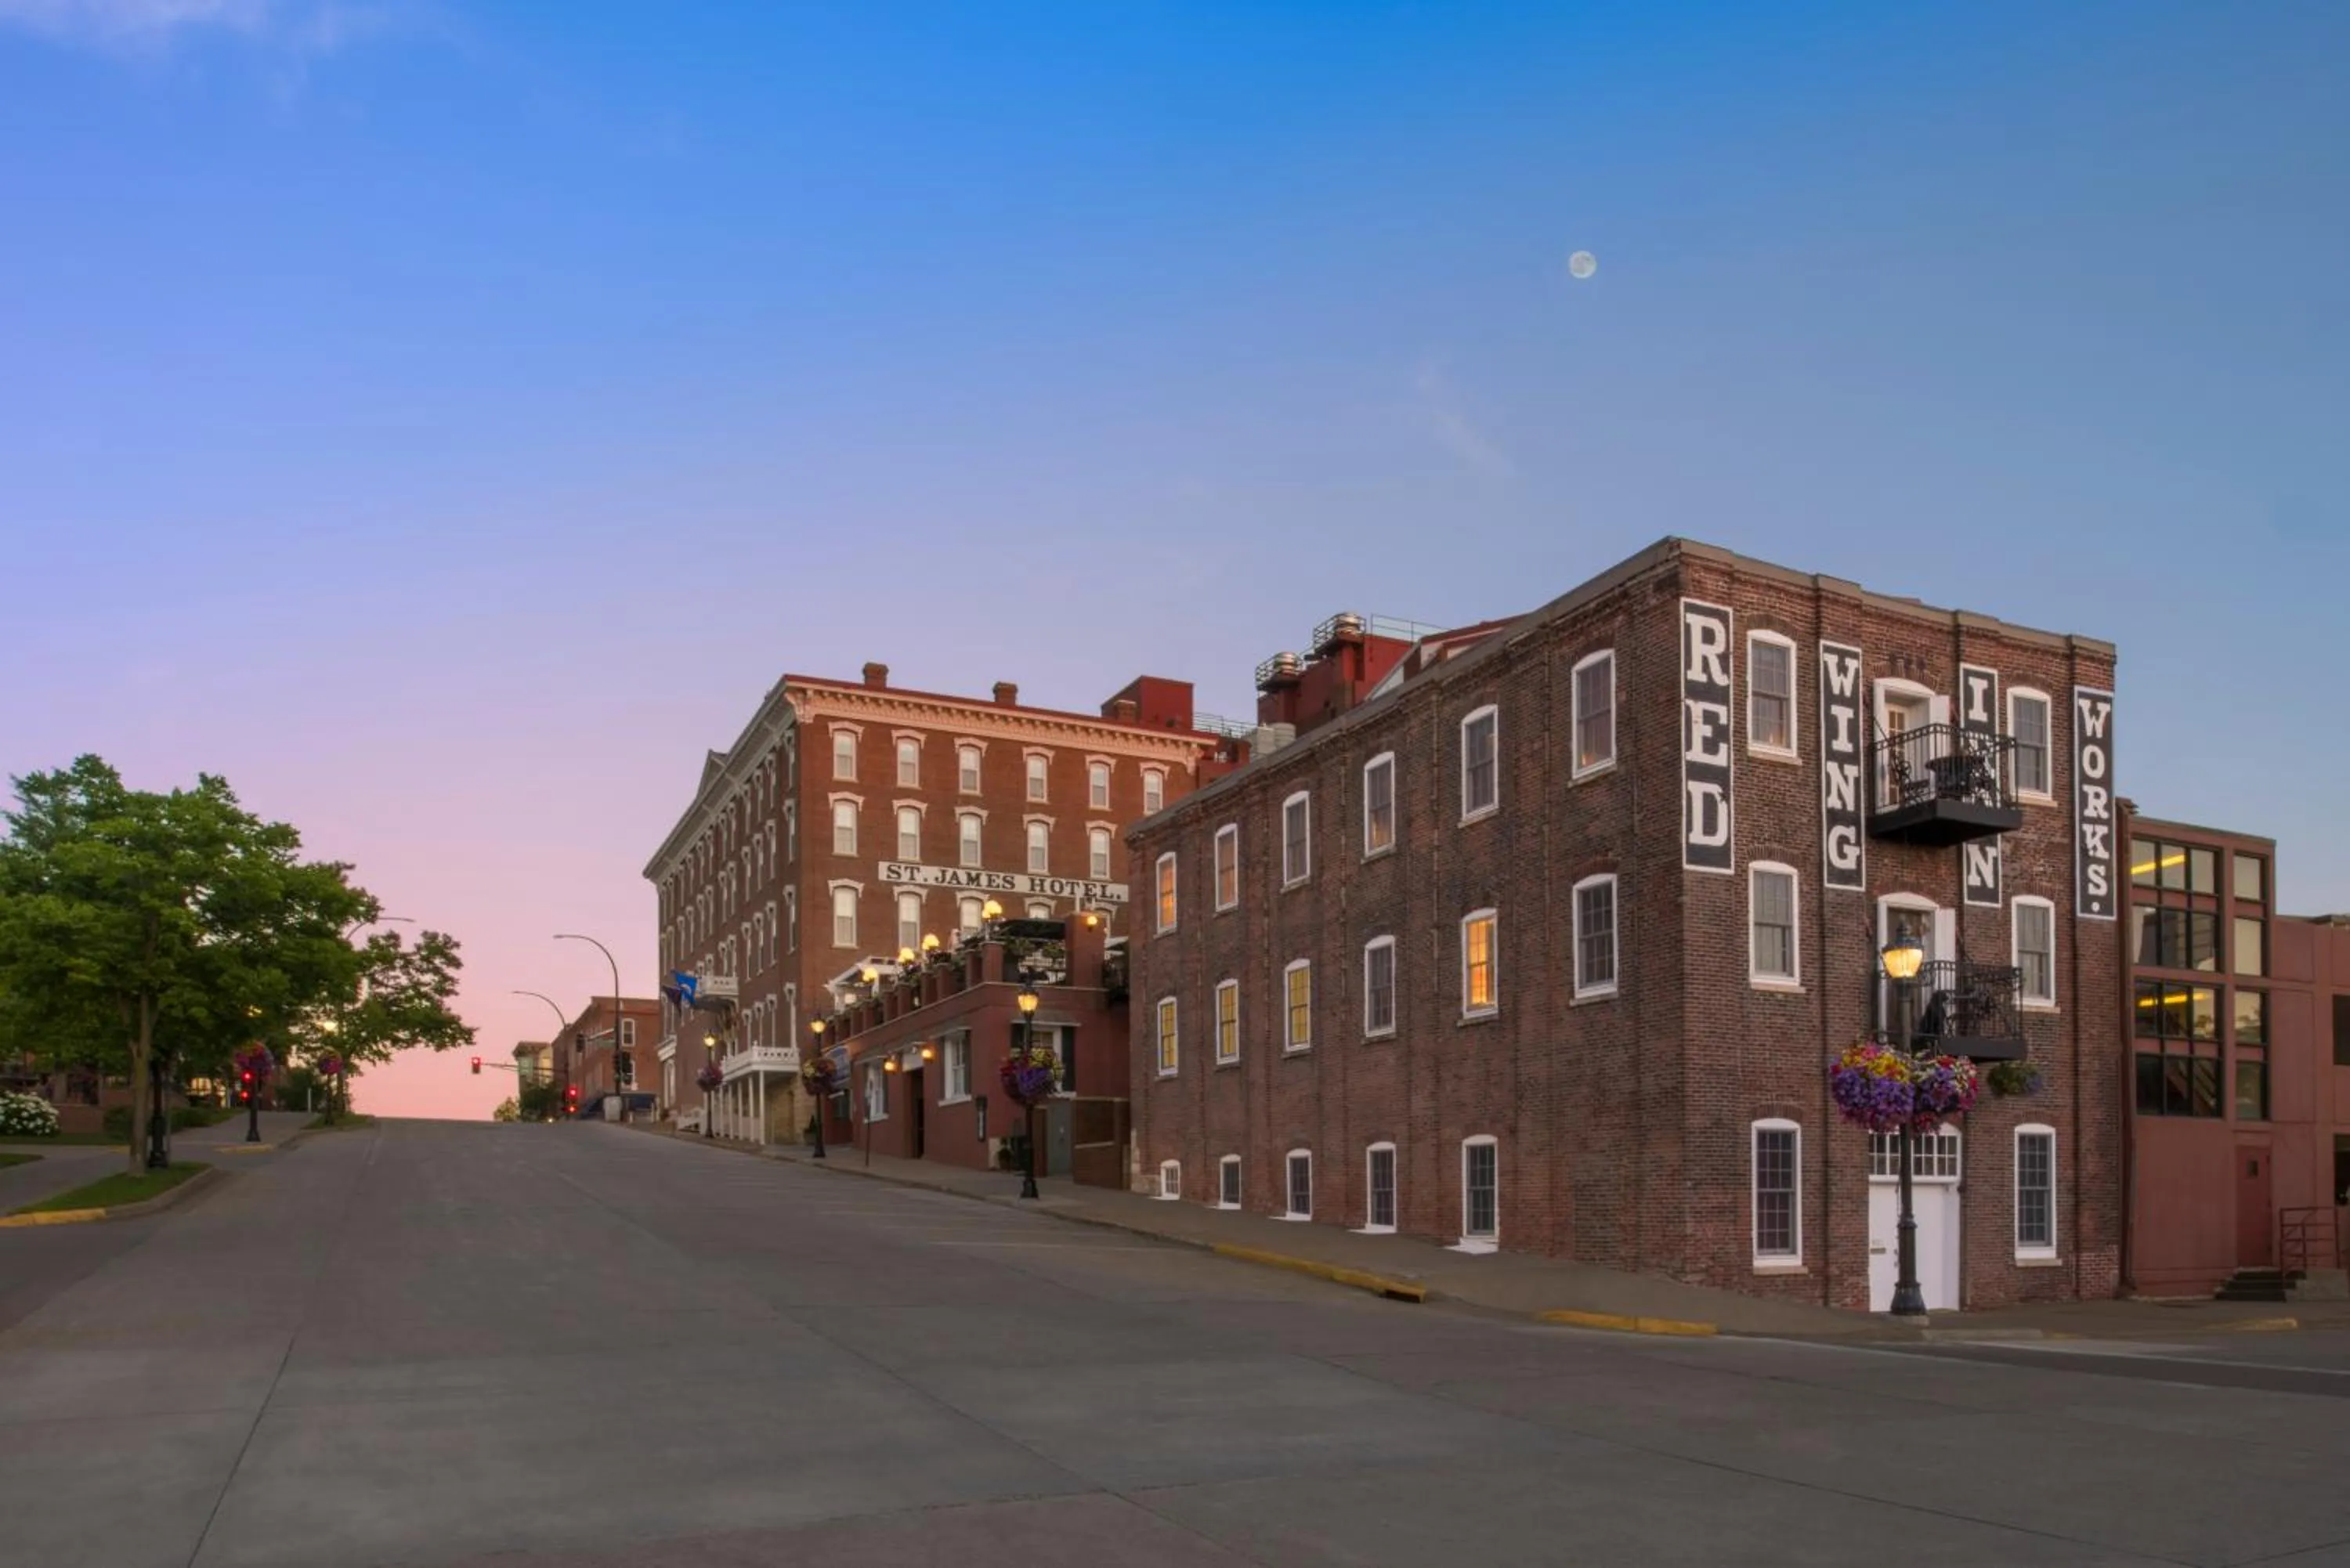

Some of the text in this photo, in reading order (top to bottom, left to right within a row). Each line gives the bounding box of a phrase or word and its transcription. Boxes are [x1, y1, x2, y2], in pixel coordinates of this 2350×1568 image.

[1685, 612, 1730, 847] RED
[1823, 652, 1860, 870] WING
[886, 864, 1122, 900] ST. JAMES HOTEL.
